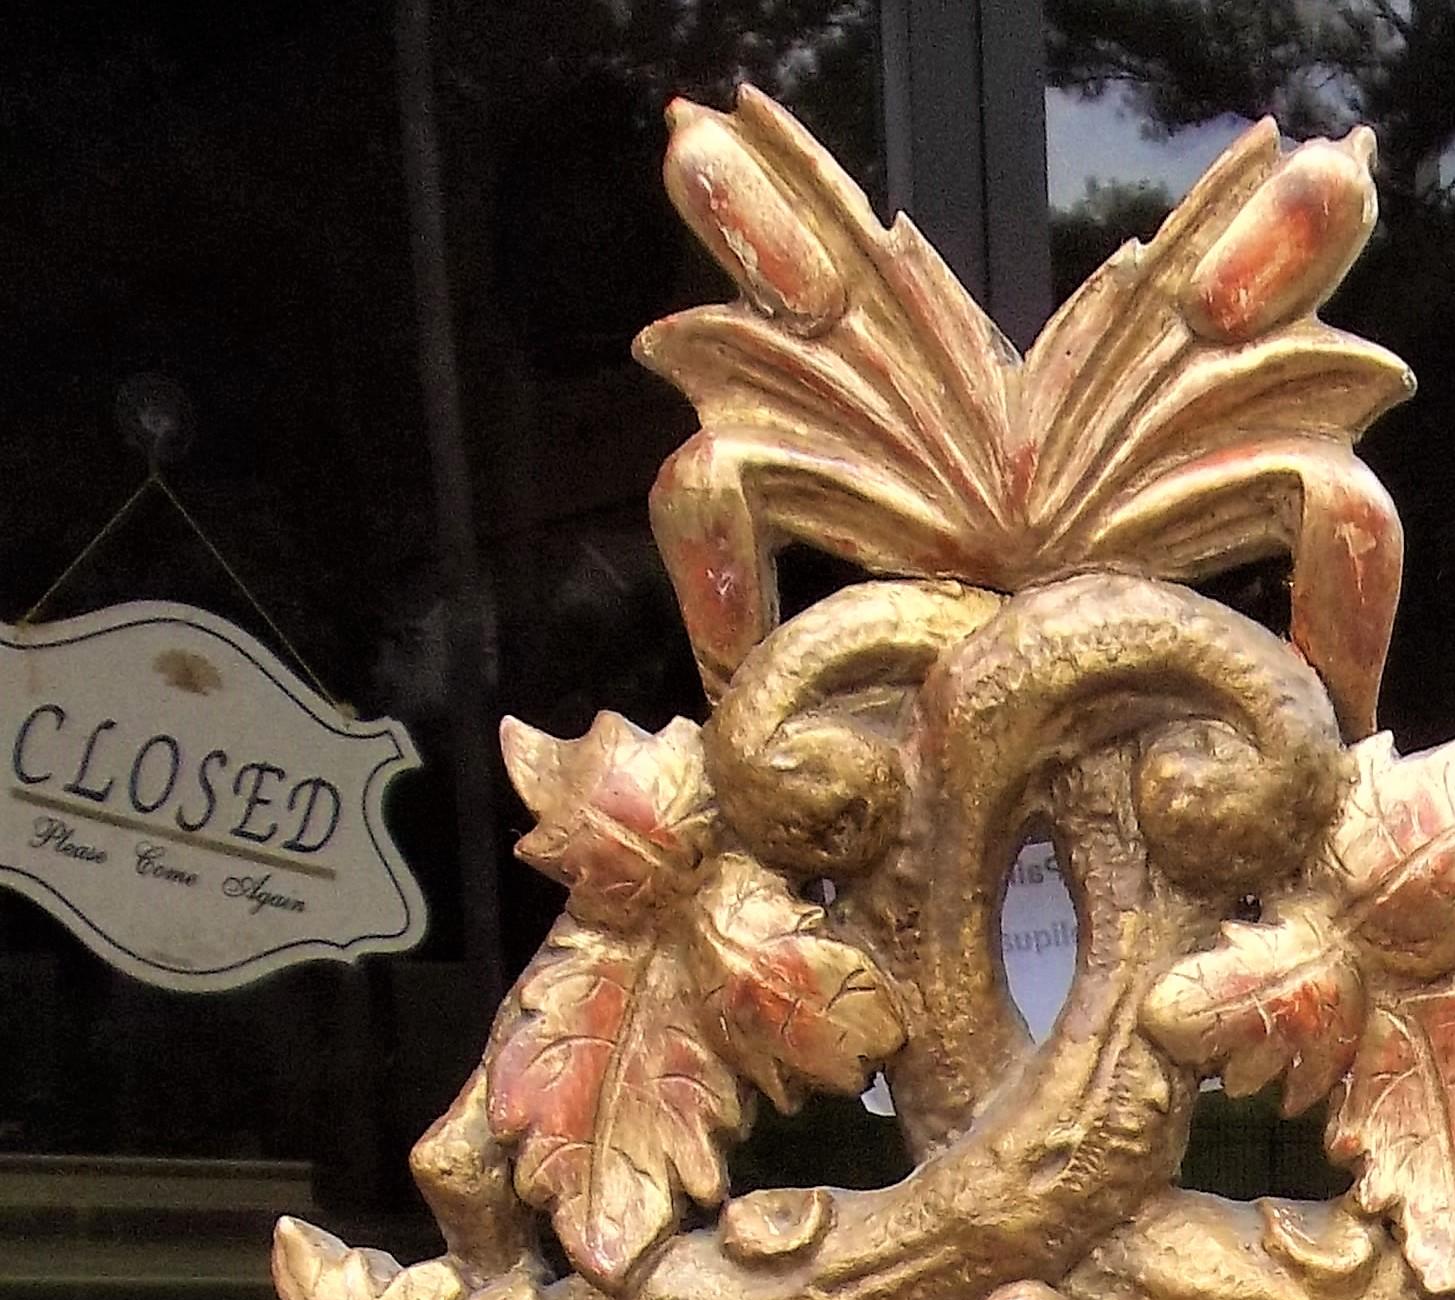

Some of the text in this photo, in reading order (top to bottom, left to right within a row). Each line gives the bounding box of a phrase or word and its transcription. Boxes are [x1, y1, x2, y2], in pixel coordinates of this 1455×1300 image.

[12, 703, 342, 853] CLOSED
[28, 815, 306, 915] Please Come Again
